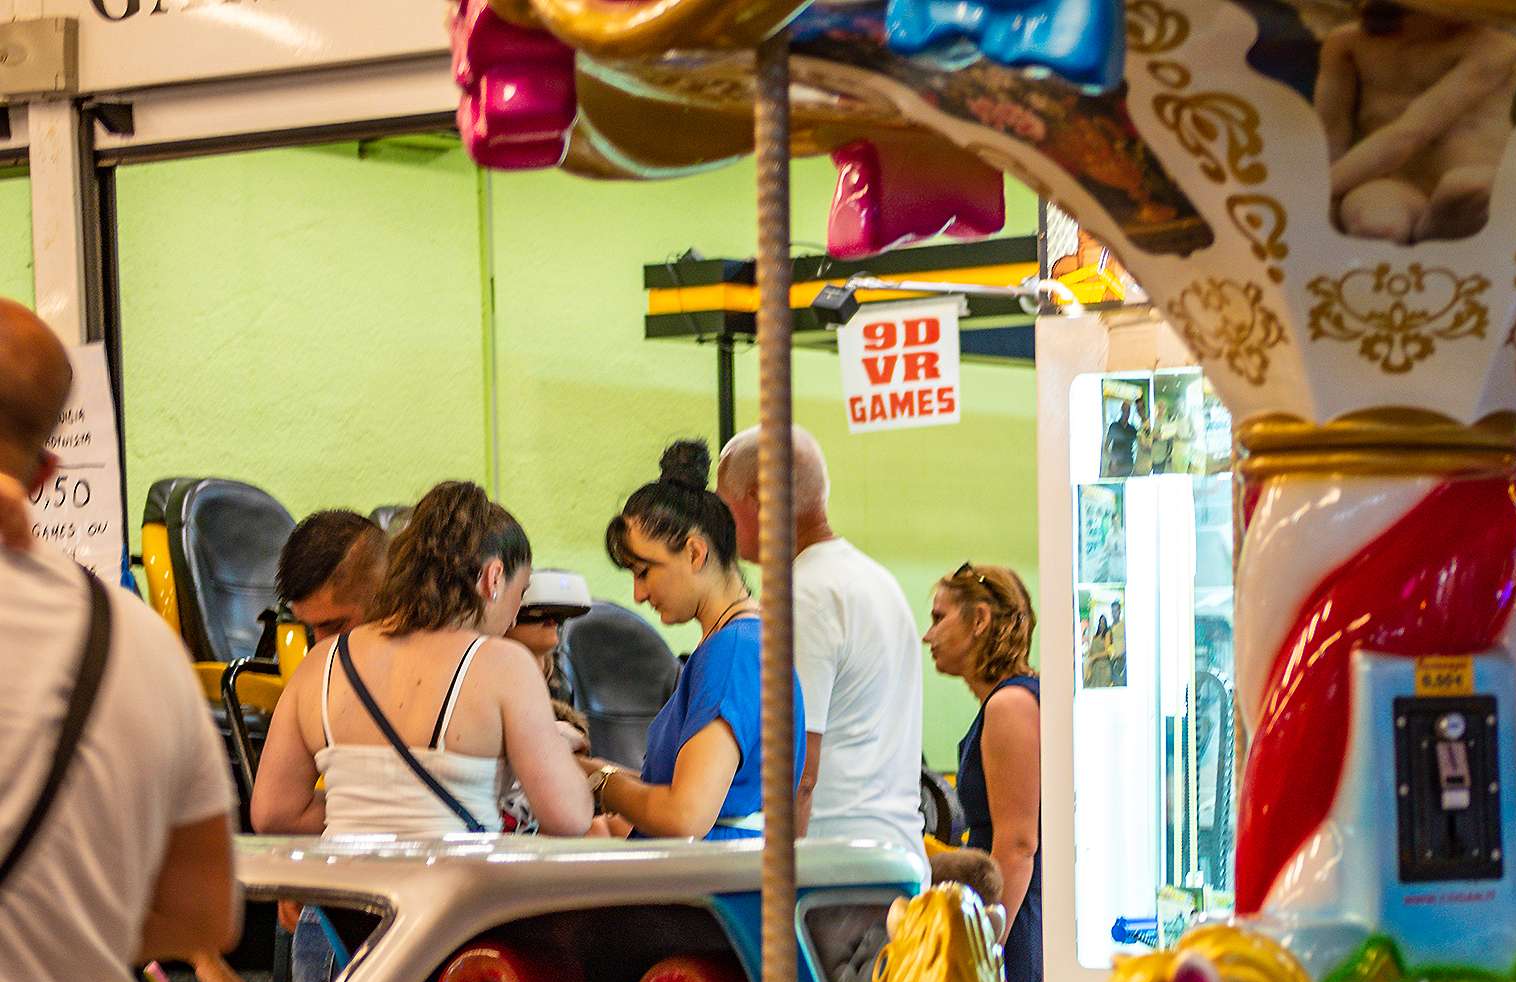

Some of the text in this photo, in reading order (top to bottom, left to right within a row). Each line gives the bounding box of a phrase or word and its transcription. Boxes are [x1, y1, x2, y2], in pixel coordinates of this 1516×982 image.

[862, 318, 941, 351] 9D
[861, 351, 941, 385] VR
[848, 386, 956, 424] GAMES
